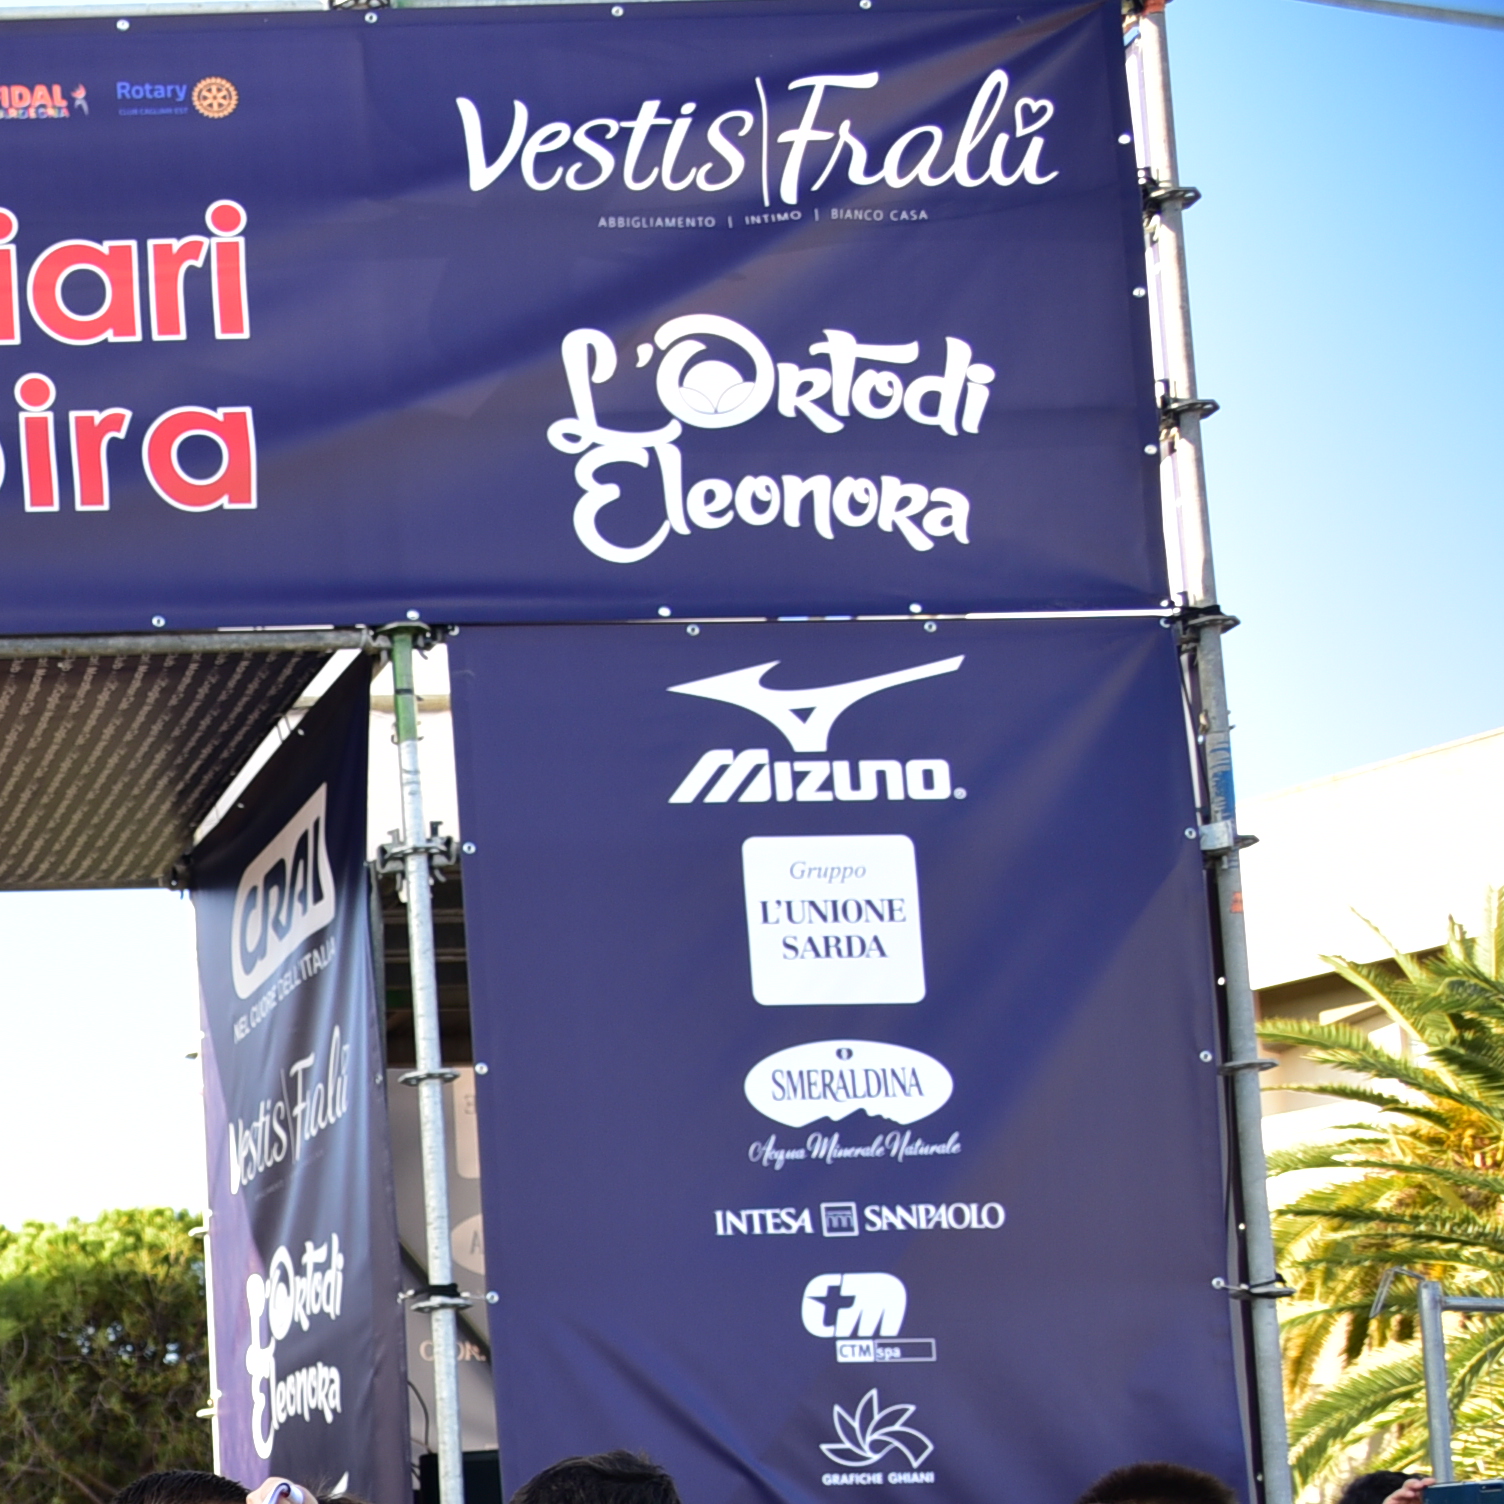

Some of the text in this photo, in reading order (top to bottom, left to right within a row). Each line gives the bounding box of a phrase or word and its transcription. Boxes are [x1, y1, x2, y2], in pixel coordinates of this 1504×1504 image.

[116, 82, 187, 101] Rotary
[455, 97, 755, 192] Vestis
[598, 208, 928, 229] ABBIGLIAMENTO INTIMO BIANCO CASA
[572, 440, 971, 564] Eleonora
[668, 748, 952, 804] MIZUNO
[788, 861, 867, 884] Gruppo
[236, 800, 327, 986] CRAI
[759, 898, 907, 926] L'UNIONE
[781, 934, 889, 960] SARDA
[770, 1067, 925, 1102] SMERALDINA
[748, 1130, 962, 1171] Acqua Minerale Naturale
[714, 1202, 1006, 1235] INTESA SANPAOLO
[839, 1343, 873, 1358] CTM
[821, 1471, 935, 1485] GRAFICHE GHIANI
